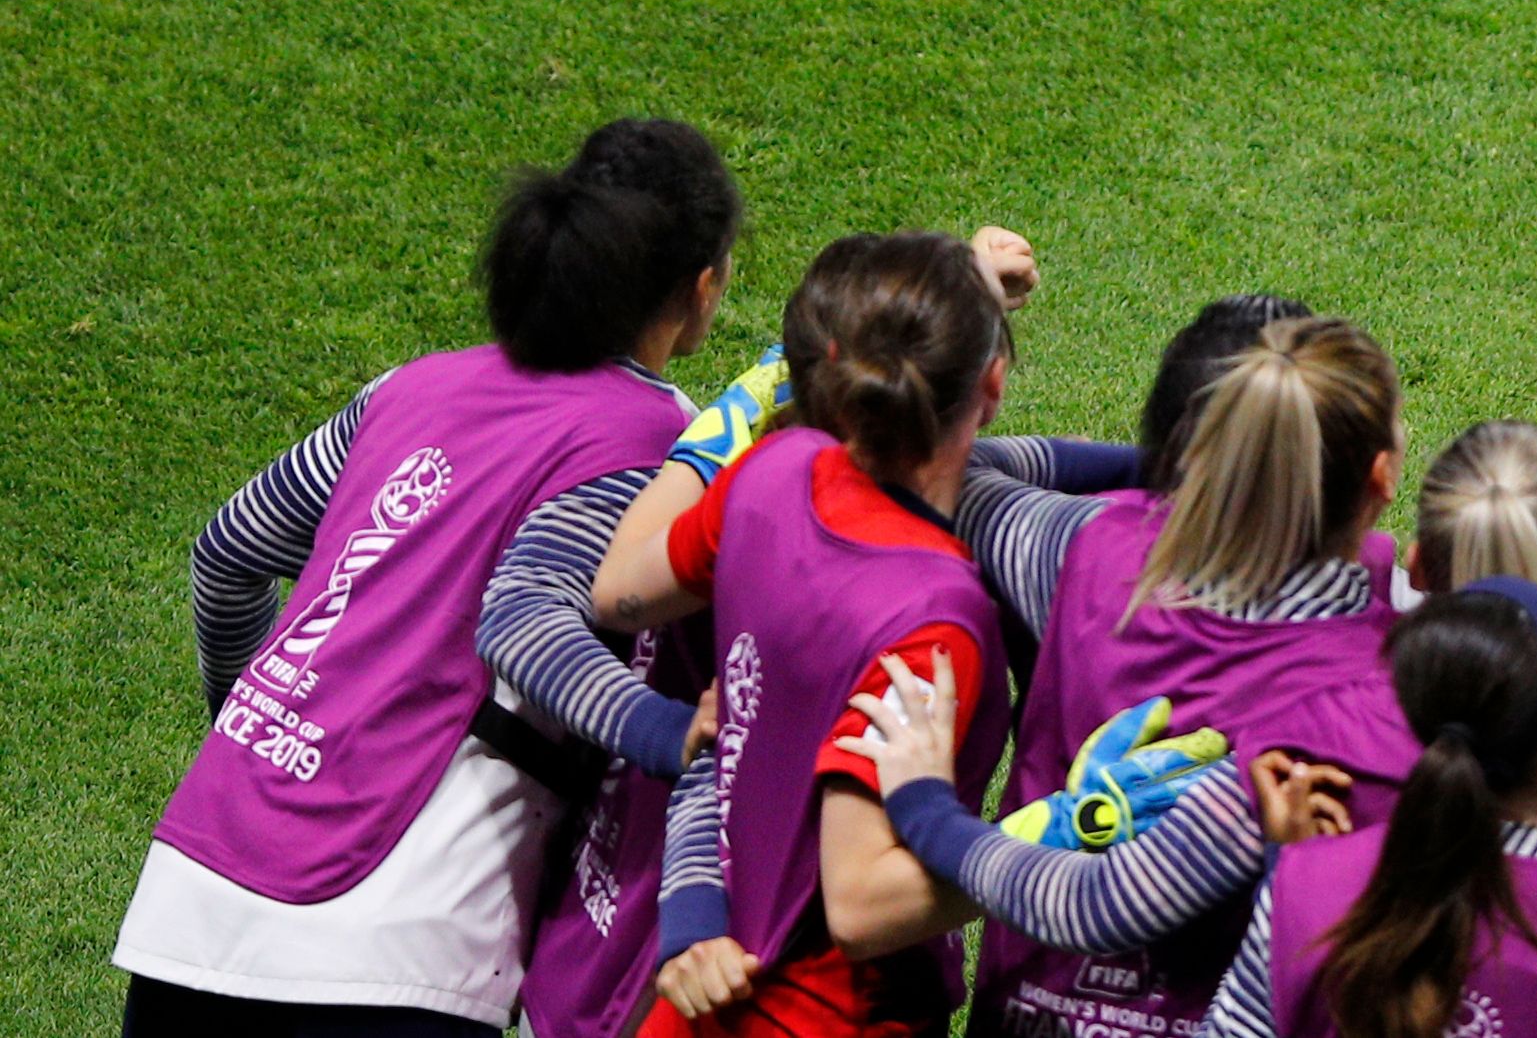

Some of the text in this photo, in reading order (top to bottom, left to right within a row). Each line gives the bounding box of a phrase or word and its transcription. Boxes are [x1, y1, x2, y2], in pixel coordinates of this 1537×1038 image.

[261, 654, 299, 685] FIFA
[250, 690, 301, 729] WORLD
[298, 721, 326, 742] CUP
[252, 725, 322, 782] 2019
[1088, 965, 1140, 990] FIFA
[1019, 980, 1203, 1037] WOMEN'S WORLD CU
